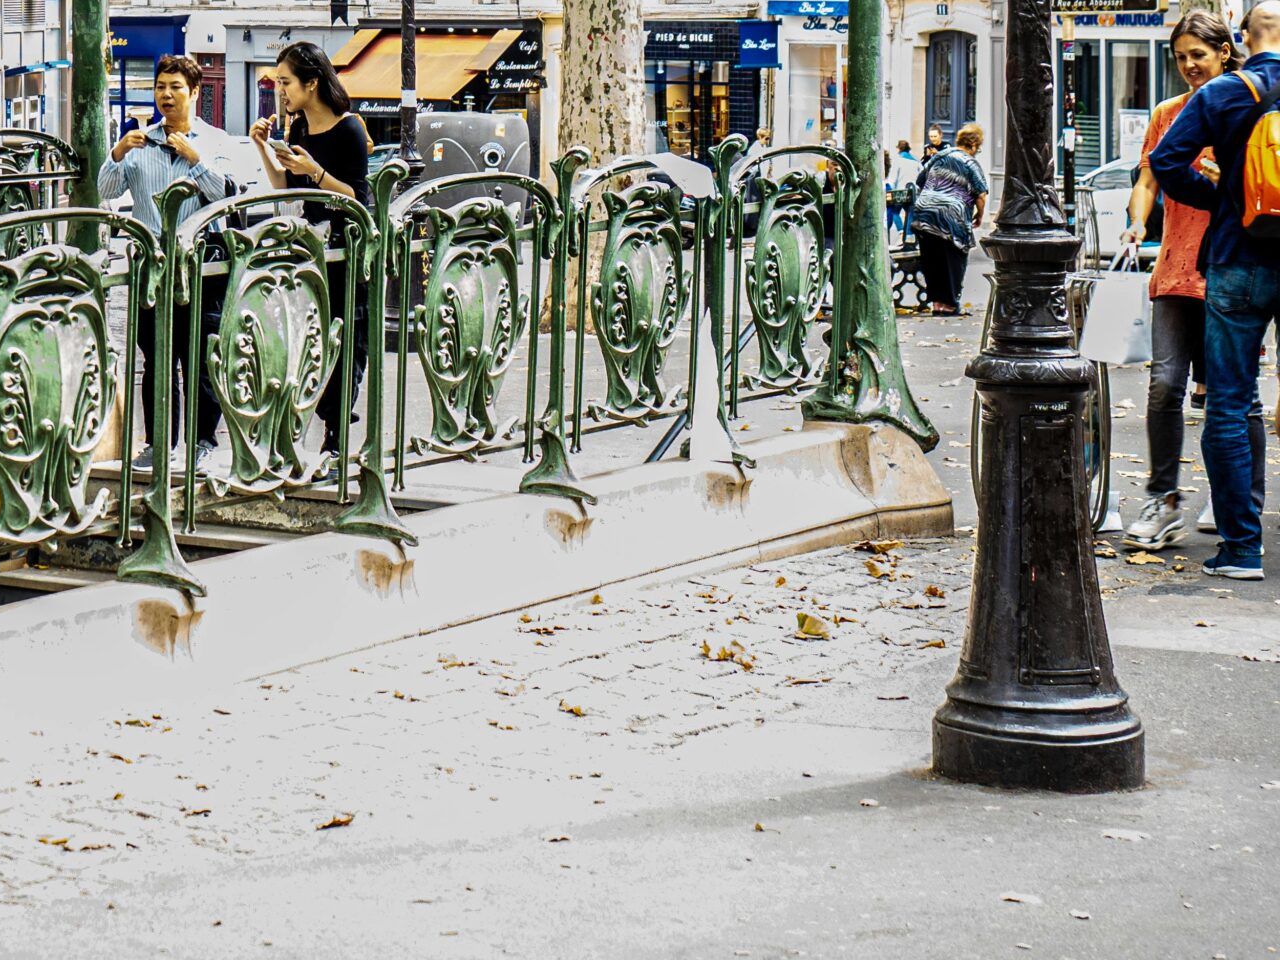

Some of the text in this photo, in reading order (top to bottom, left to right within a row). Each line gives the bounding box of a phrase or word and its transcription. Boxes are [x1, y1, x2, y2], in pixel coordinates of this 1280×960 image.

[654, 33, 674, 42] PIED
[676, 32, 687, 42] de
[518, 40, 539, 55] Café
[495, 59, 539, 71] Restaurant
[358, 100, 403, 113] Restaurant
